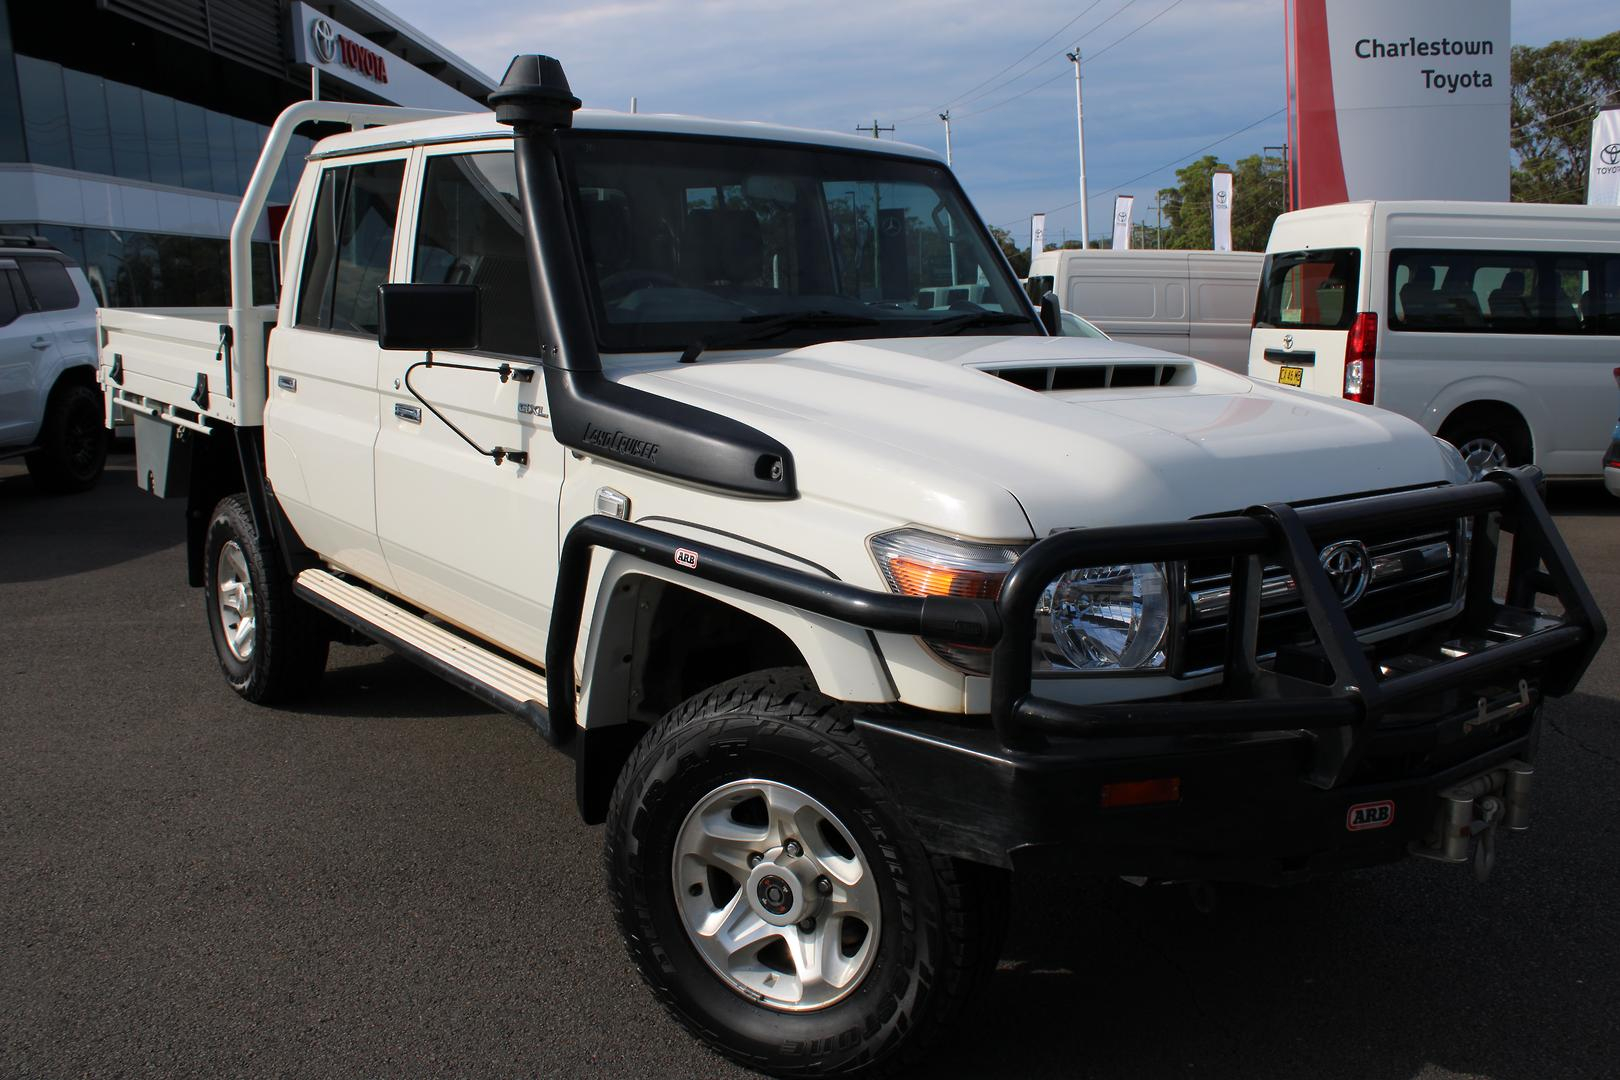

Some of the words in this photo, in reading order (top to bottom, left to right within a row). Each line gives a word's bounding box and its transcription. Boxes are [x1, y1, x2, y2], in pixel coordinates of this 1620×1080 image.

[1354, 37, 1493, 59] Charlestown
[338, 34, 388, 84] TOYOTA
[1421, 69, 1493, 93] Toyota
[518, 403, 549, 419] GXL
[677, 551, 695, 565] ARB
[1353, 805, 1389, 824] ARB
